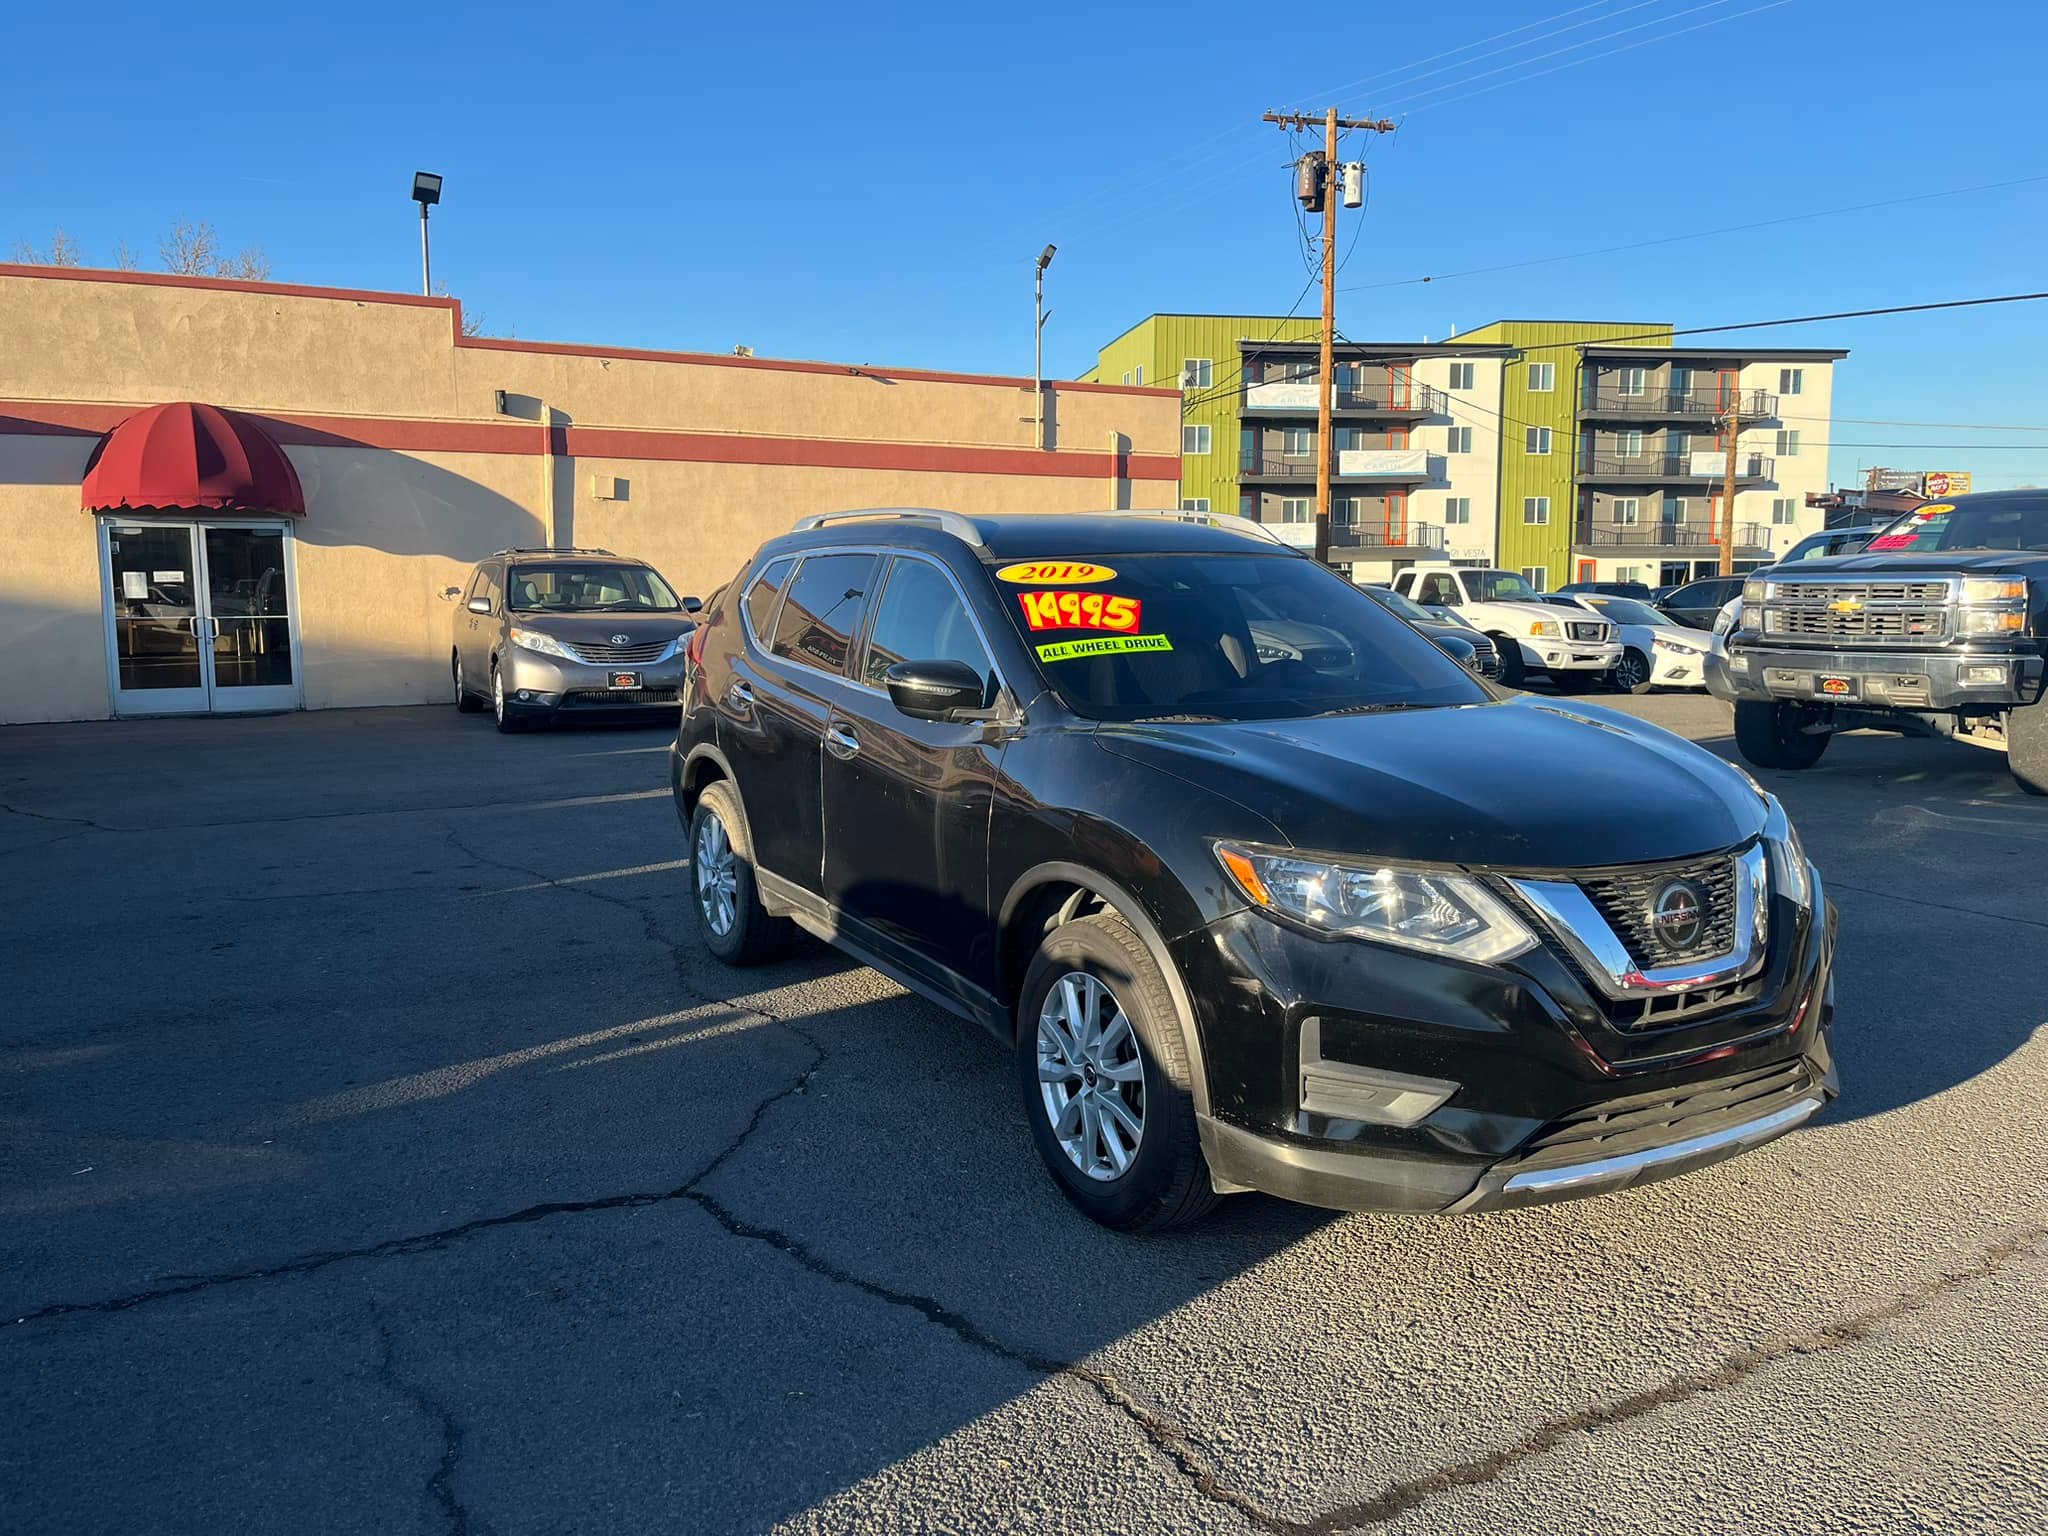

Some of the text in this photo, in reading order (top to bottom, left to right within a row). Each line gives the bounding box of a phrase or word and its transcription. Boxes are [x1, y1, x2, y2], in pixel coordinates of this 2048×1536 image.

[1019, 565, 1095, 580] 2019
[1023, 592, 1139, 630] 14995
[1043, 638, 1166, 658] ALL WHEEL DRIVE
[1661, 910, 1700, 924] NISSAN
